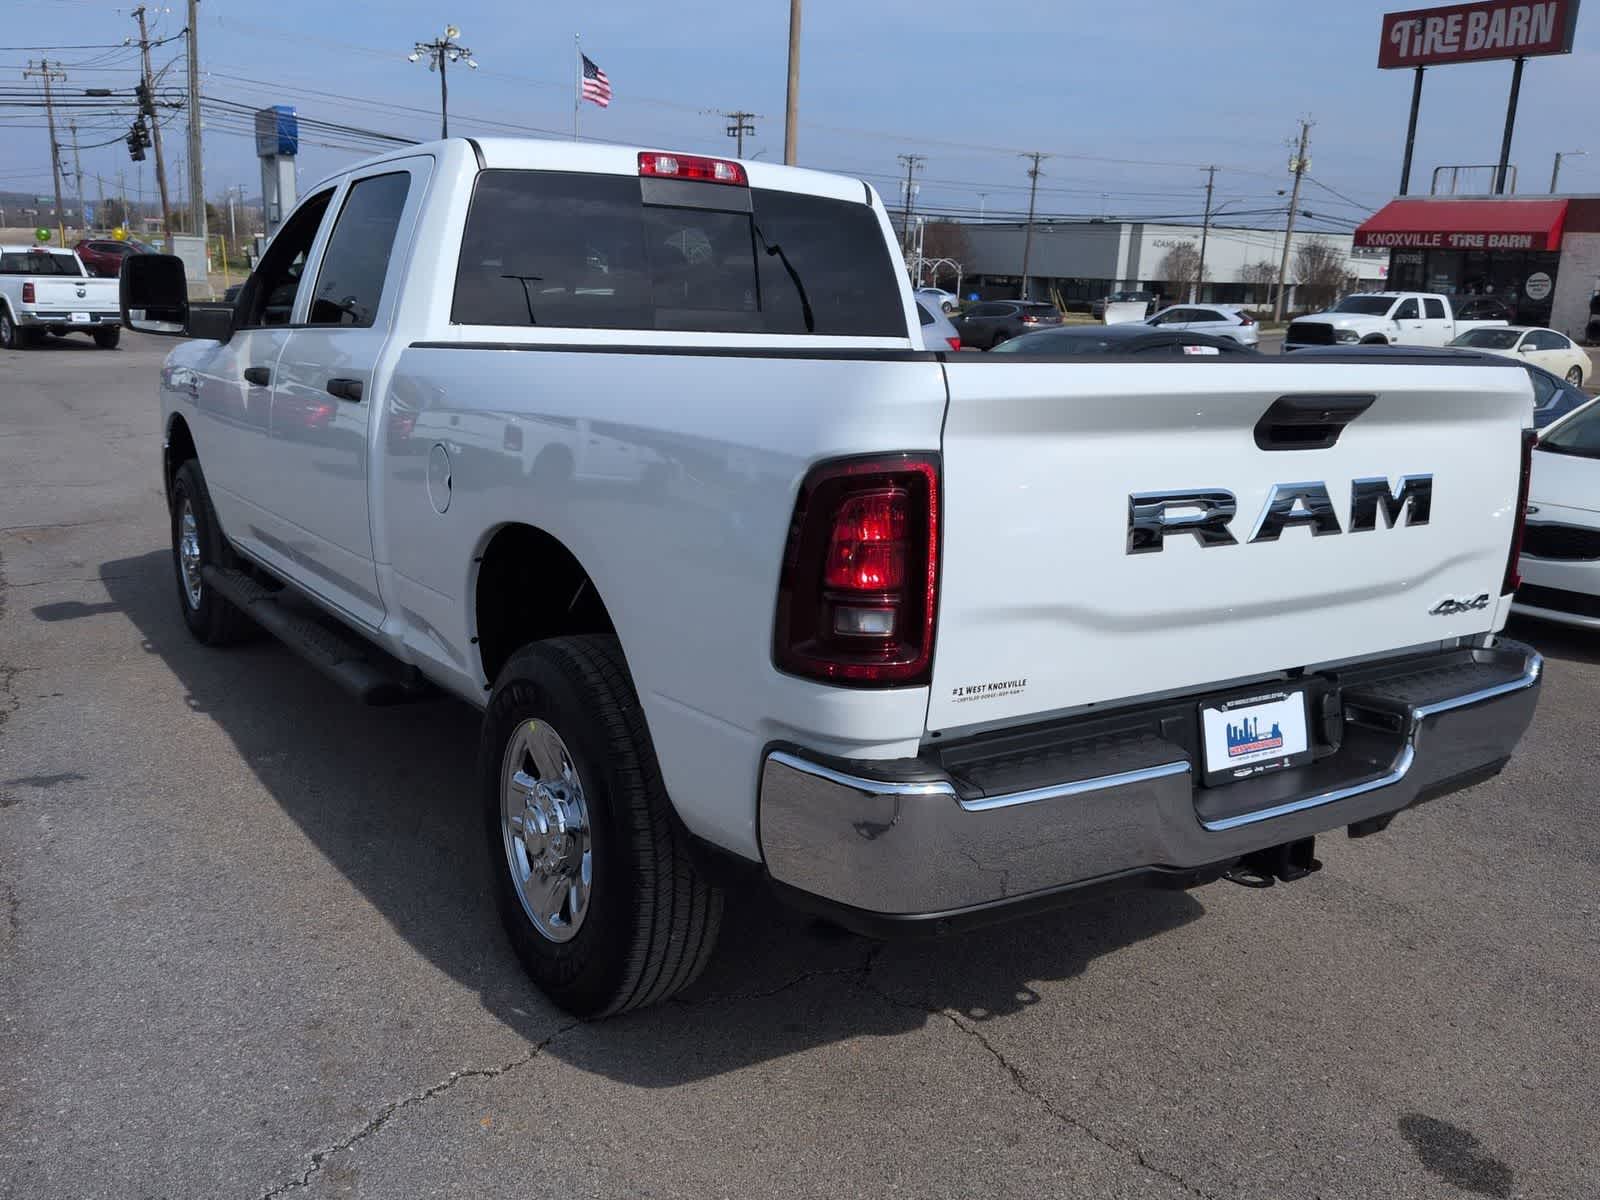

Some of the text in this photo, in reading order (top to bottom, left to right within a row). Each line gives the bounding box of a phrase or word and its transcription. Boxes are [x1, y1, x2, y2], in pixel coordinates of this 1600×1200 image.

[1464, 1, 1557, 51] BARN
[1366, 233, 1442, 247] KNOXVILLE
[1488, 234, 1532, 249] BARN
[1126, 472, 1434, 556] RAM
[952, 678, 1028, 697] #1 WEST KNOXVILLE
